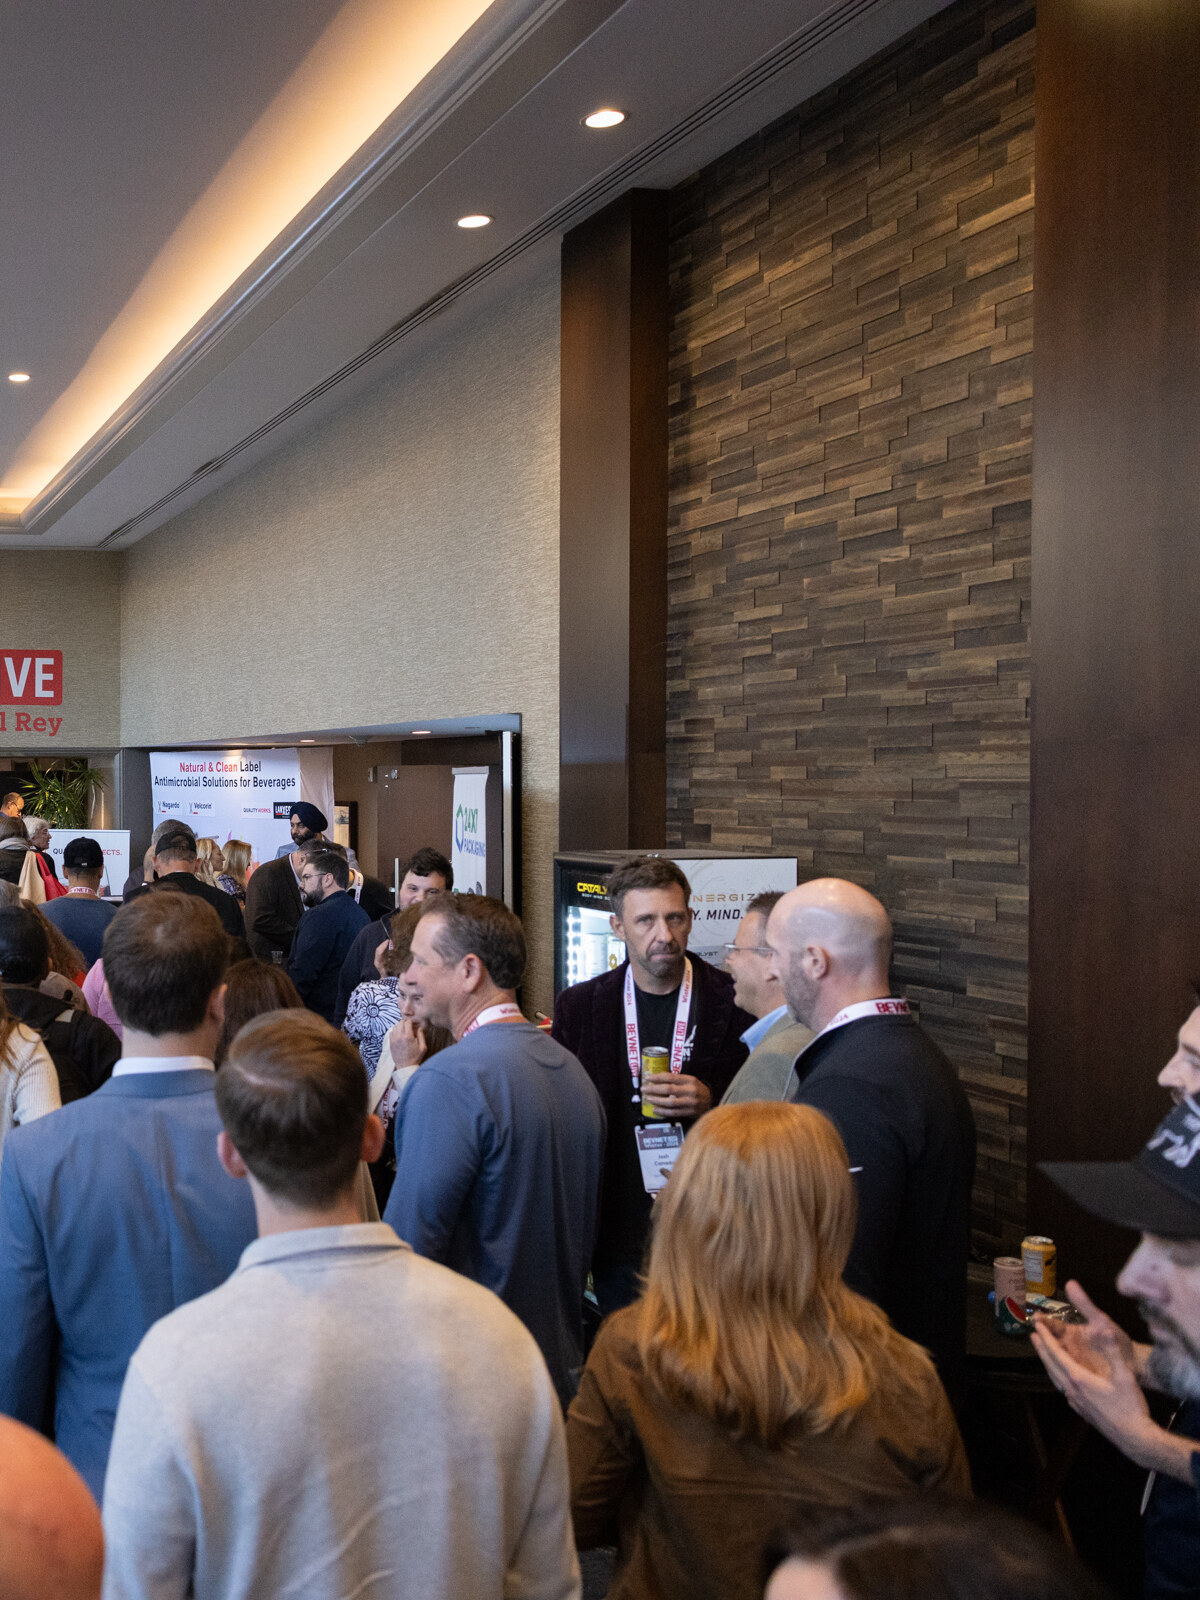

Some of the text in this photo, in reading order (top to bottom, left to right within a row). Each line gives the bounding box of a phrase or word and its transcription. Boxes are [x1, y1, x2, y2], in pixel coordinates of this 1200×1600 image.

[14, 712, 63, 737] Rey
[179, 760, 262, 773] Natural & Clean Label
[154, 776, 296, 790] Antimicrobial Solutions for Beverages
[576, 882, 608, 895] CATALY
[692, 893, 756, 903] NERGIZ
[706, 909, 744, 920] MIND.
[626, 1023, 639, 1064] BEVNET
